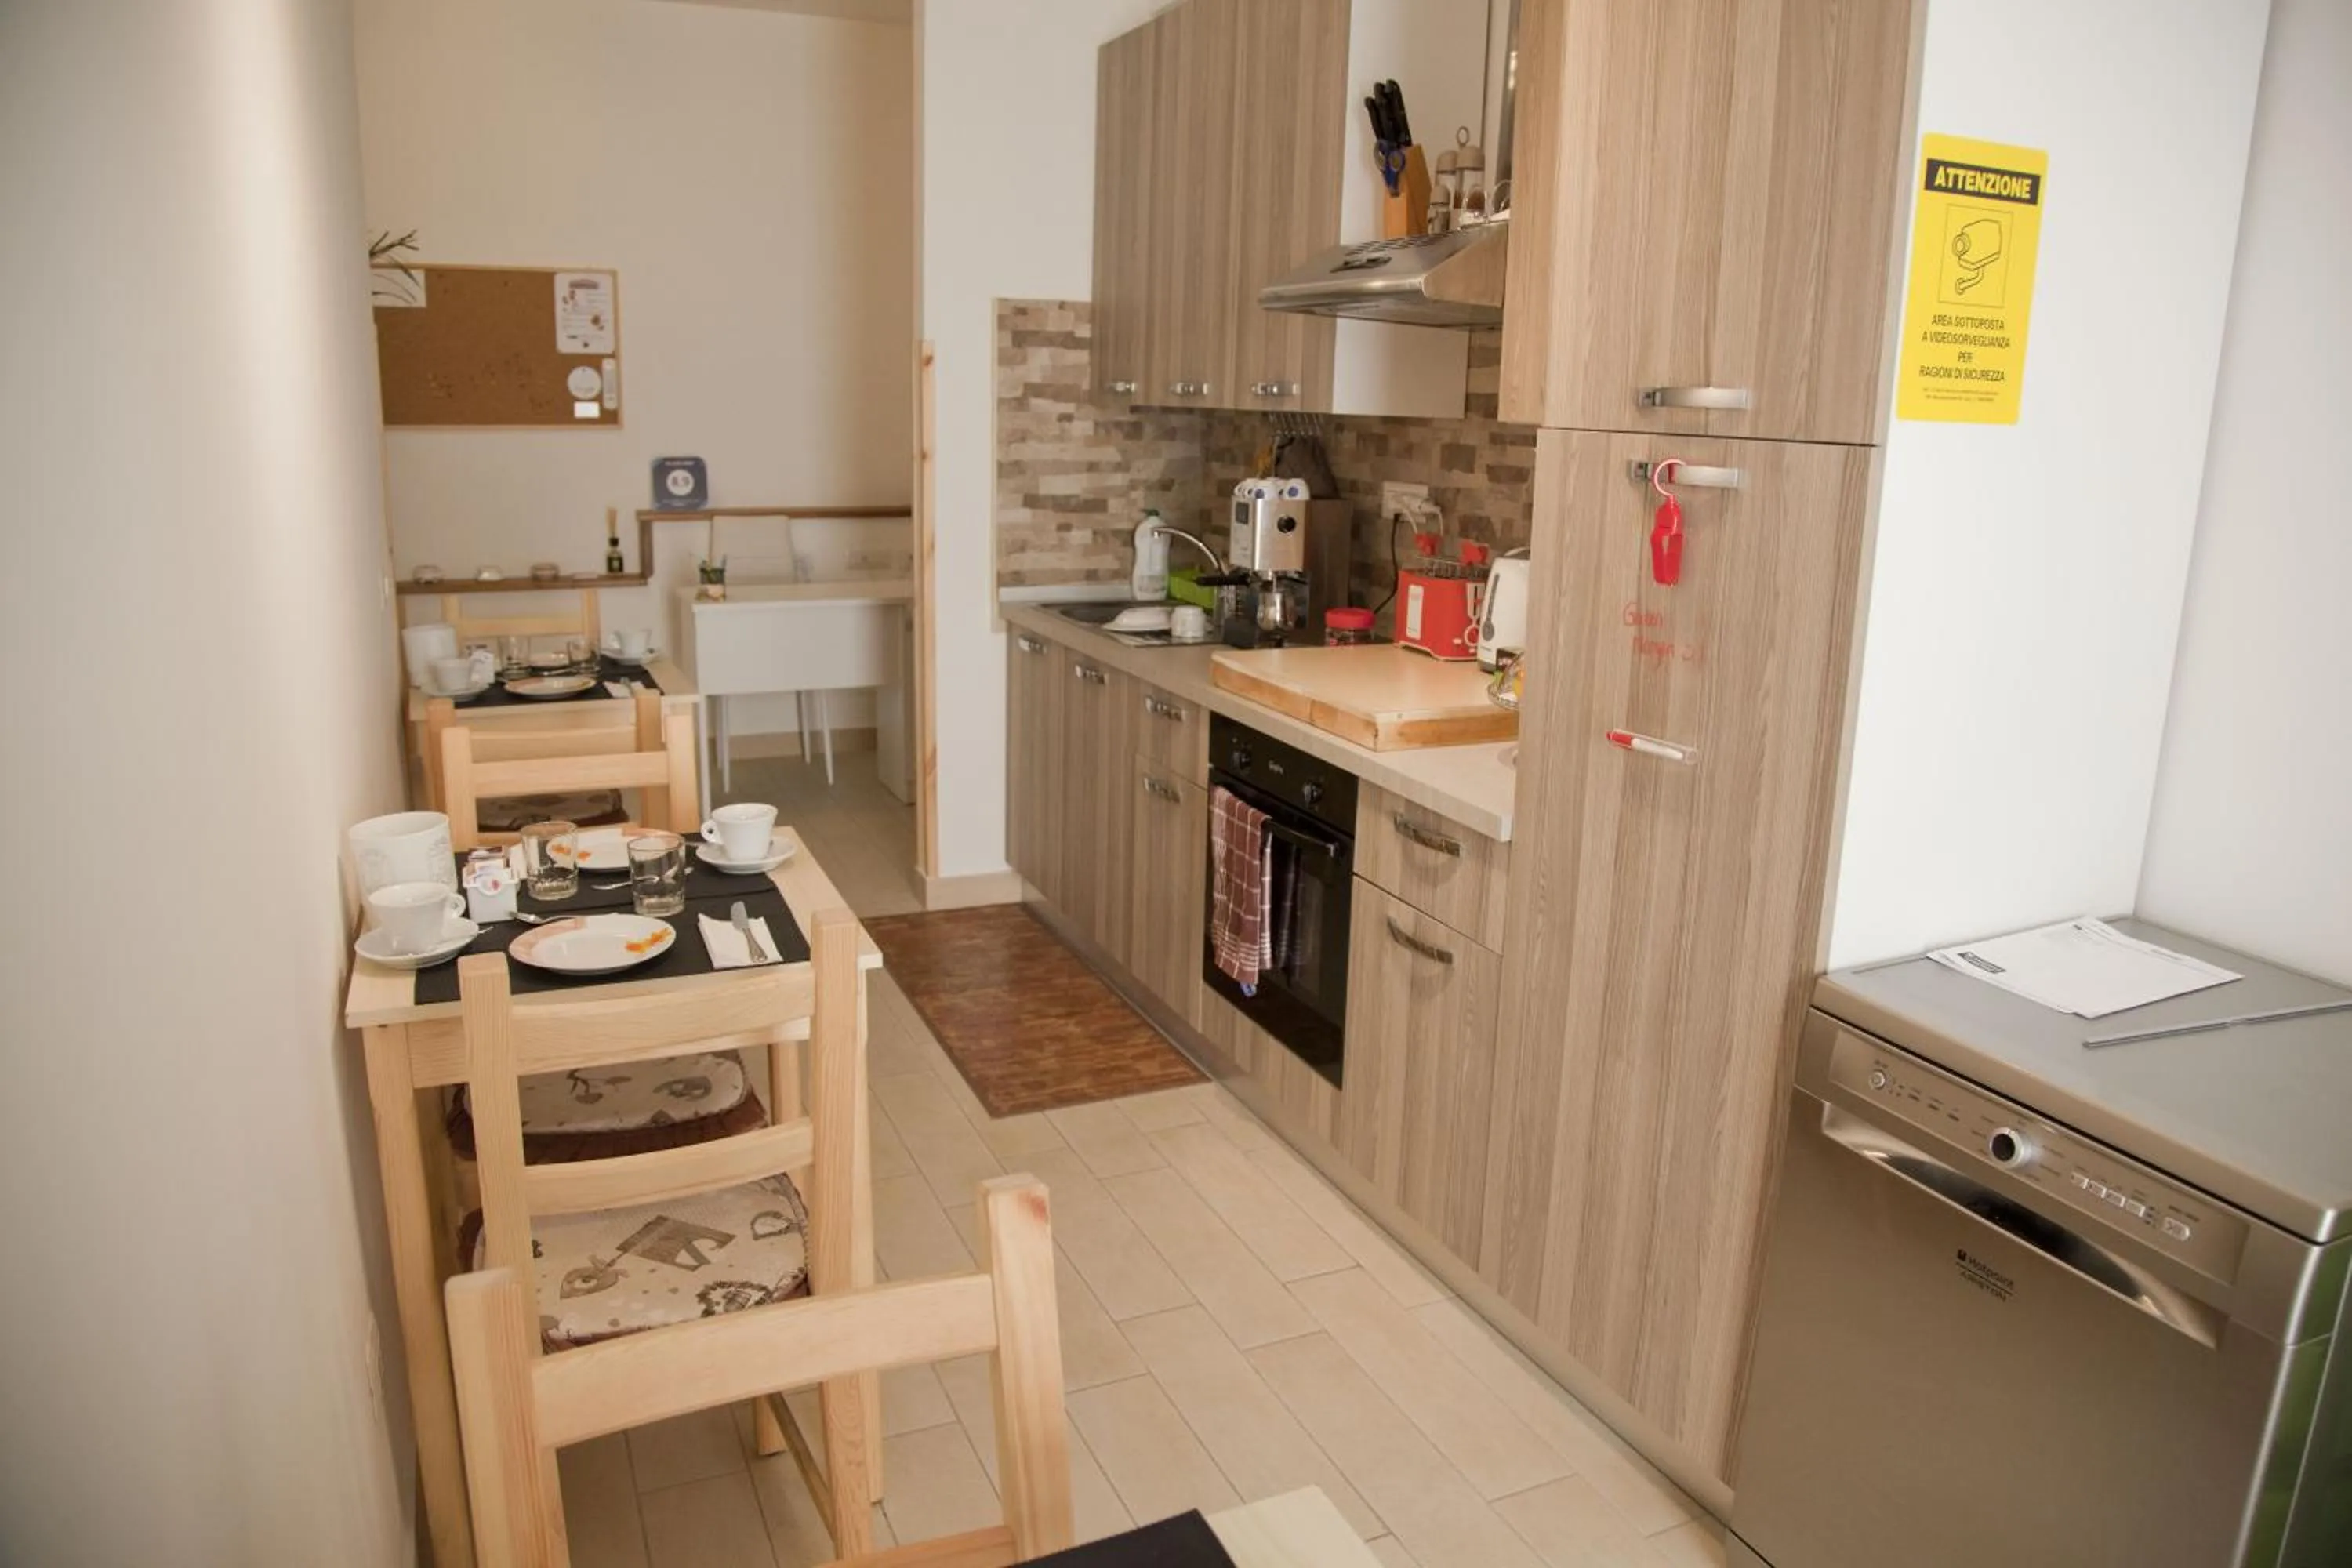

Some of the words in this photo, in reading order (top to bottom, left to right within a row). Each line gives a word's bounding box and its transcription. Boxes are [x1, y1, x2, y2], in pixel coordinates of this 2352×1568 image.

[1934, 165, 2032, 199] ATTENZIONE
[1931, 314, 1953, 327] AREA
[1955, 316, 2005, 330] SOTTOPOSTA
[1921, 330, 1928, 342] A
[1929, 331, 2010, 349] VIDEOSORVEGLIANZA
[1957, 350, 1973, 362] PER
[1918, 365, 1953, 379] RAGIONI
[1954, 367, 1962, 379] DI
[1963, 368, 2005, 382] SICUREZZA
